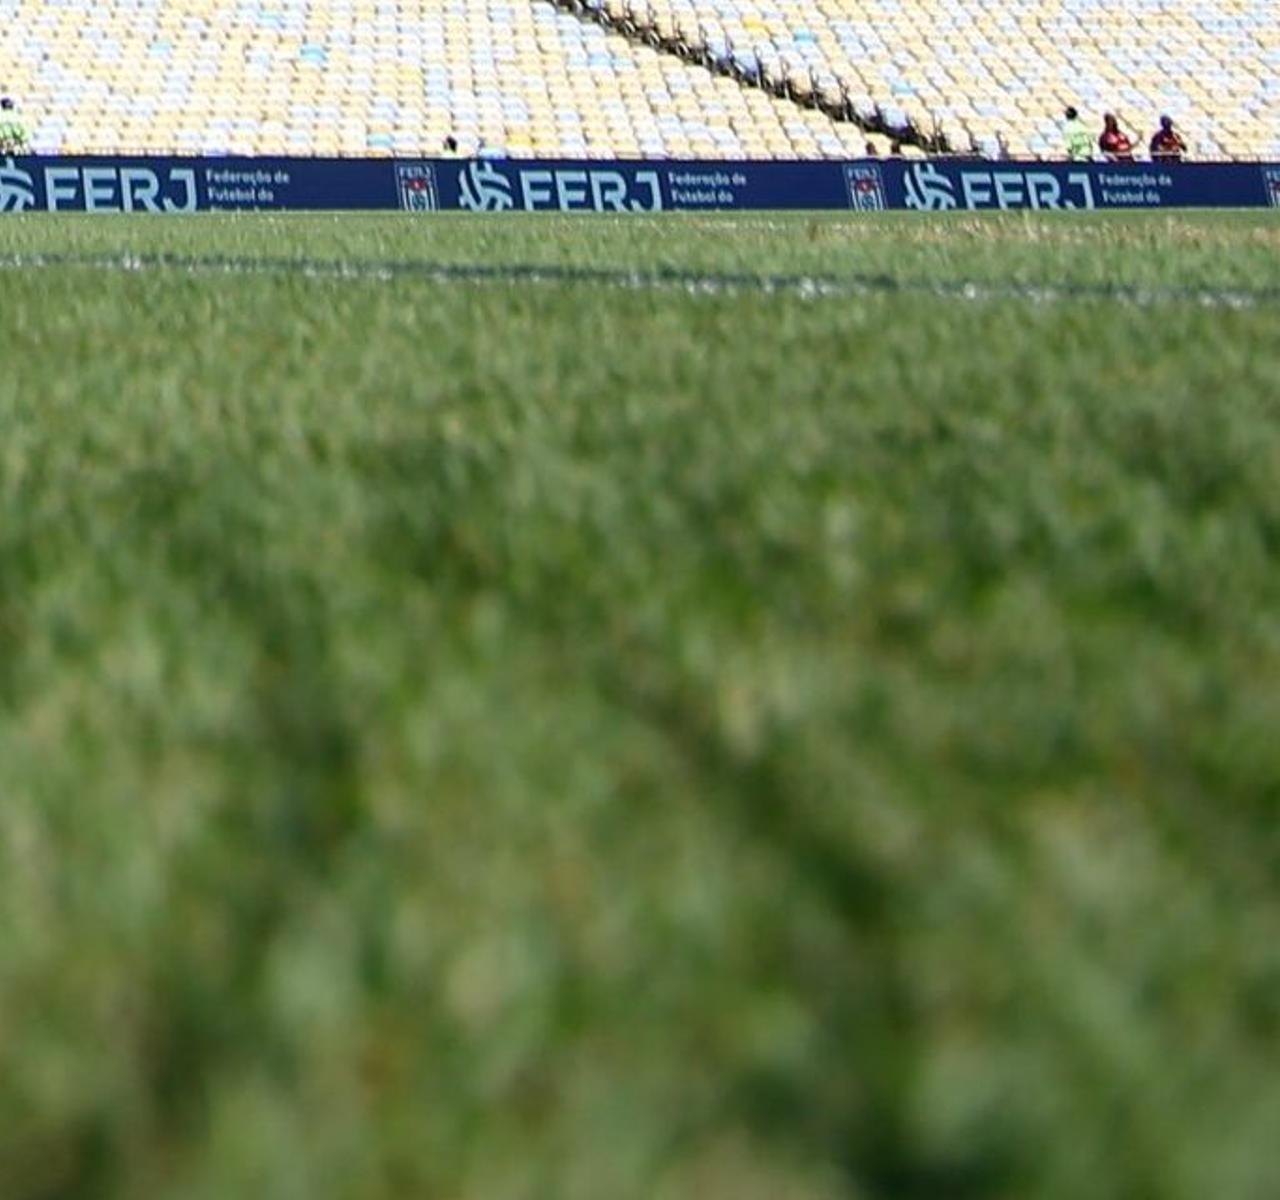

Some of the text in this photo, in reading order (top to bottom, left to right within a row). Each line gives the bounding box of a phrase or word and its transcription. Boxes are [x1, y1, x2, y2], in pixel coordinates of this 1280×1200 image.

[44, 167, 197, 212] FERJ
[206, 169, 290, 186] Federação de
[207, 187, 274, 202] Futebol do
[519, 170, 662, 212] FERJ
[961, 173, 1095, 210] FERJ
